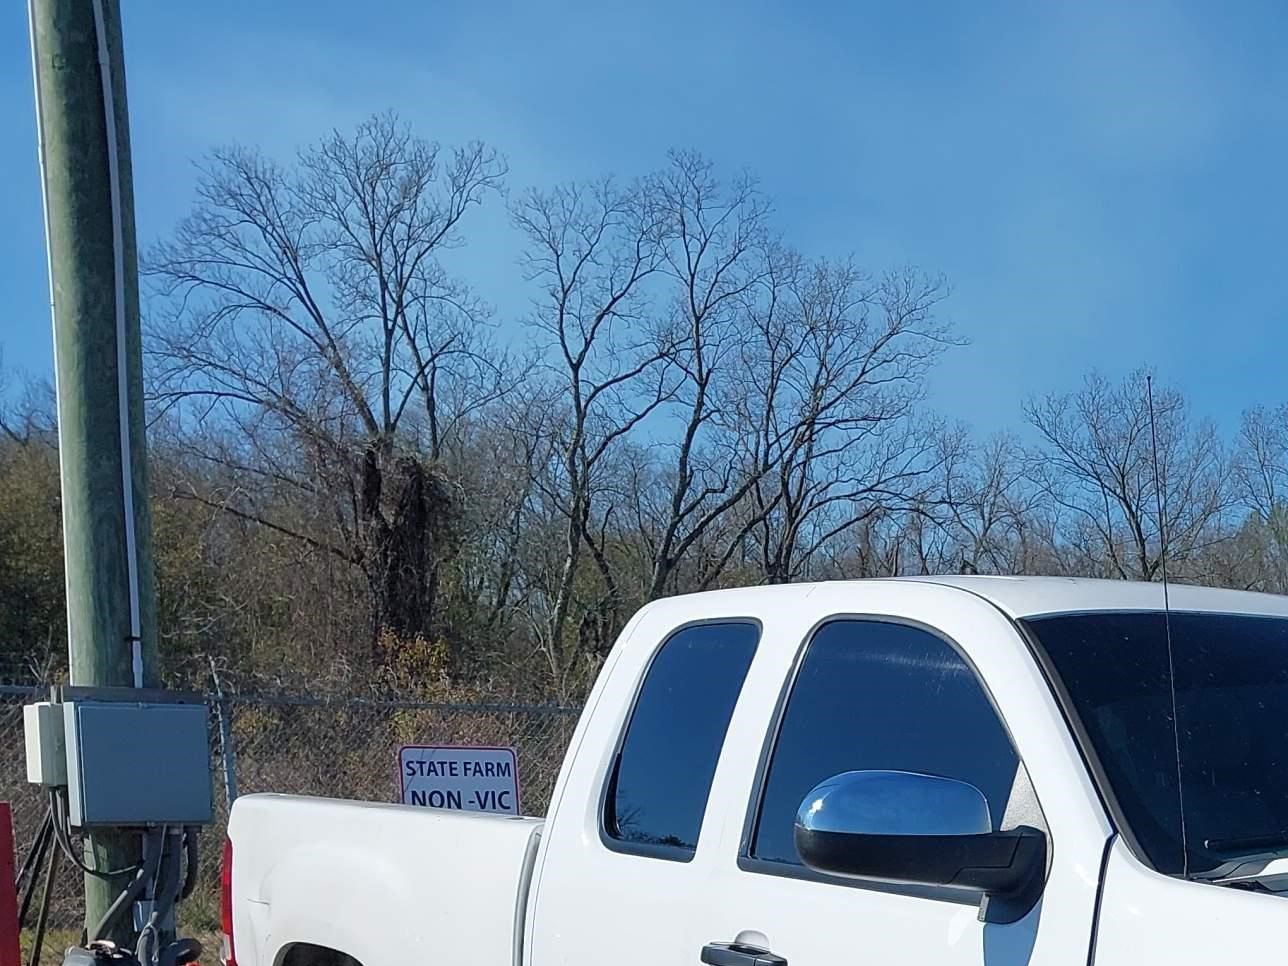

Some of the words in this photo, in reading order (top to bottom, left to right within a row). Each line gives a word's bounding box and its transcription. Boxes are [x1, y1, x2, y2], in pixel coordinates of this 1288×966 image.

[406, 760, 458, 777] STATE
[463, 761, 511, 778] FARM
[411, 790, 462, 809] NON
[468, 790, 511, 810] -VIC
